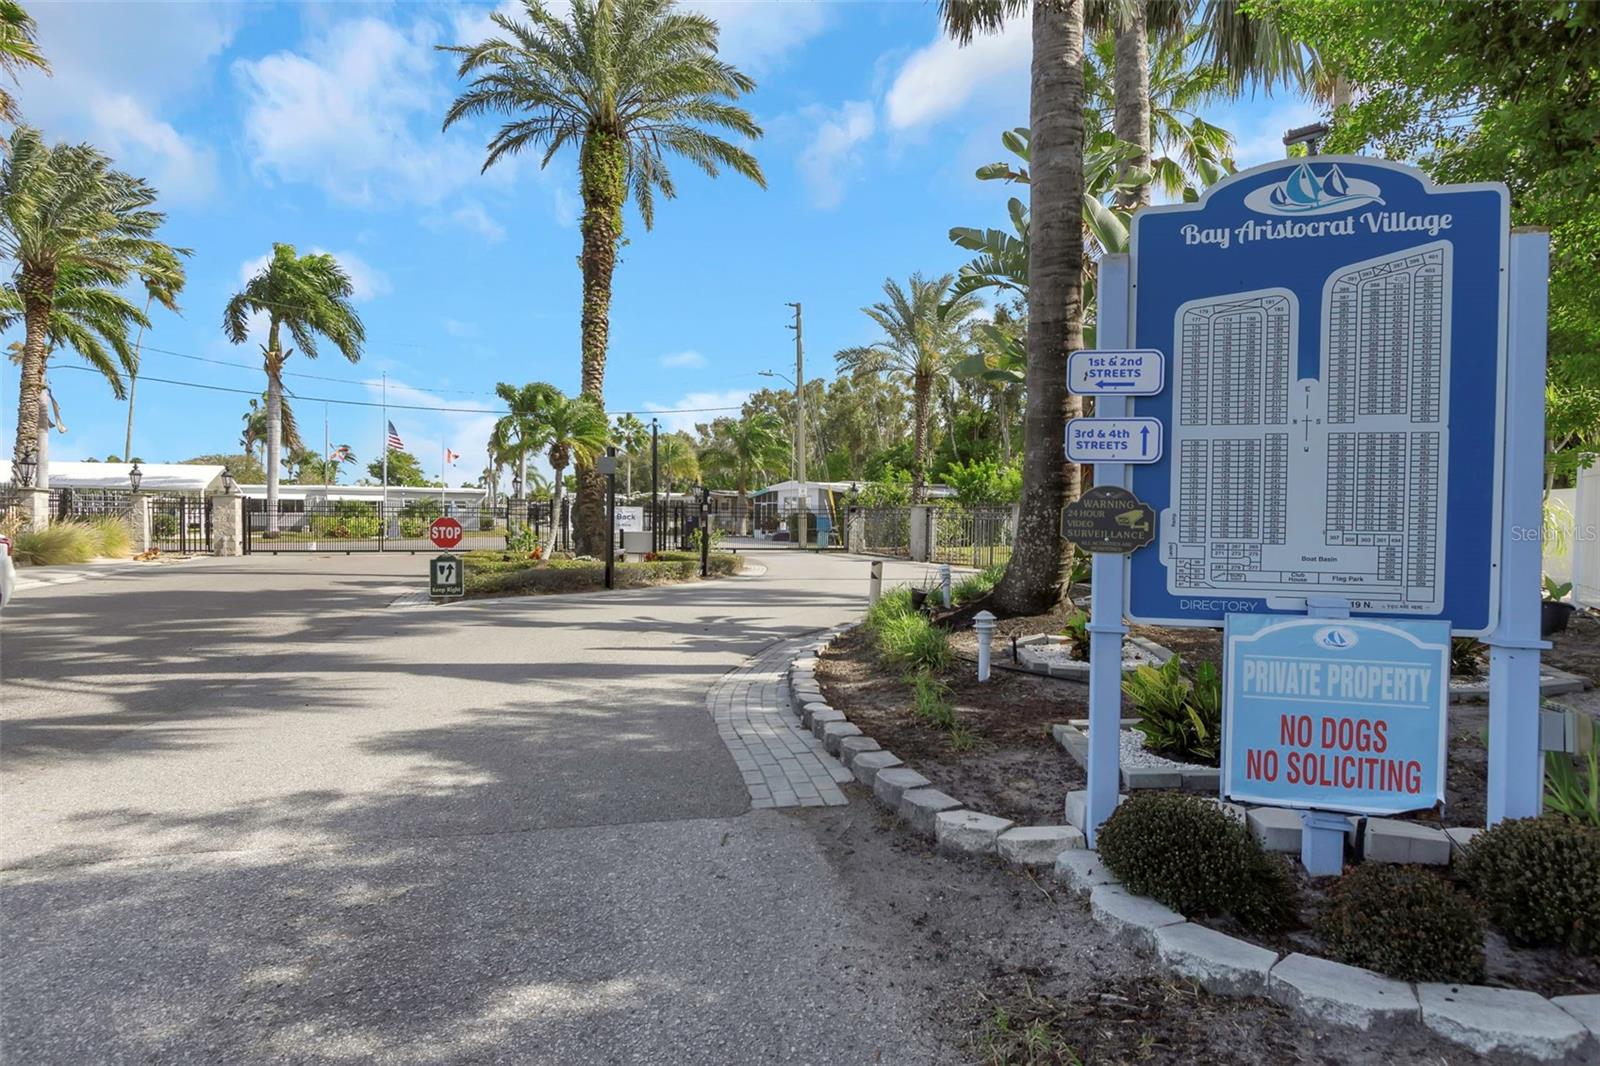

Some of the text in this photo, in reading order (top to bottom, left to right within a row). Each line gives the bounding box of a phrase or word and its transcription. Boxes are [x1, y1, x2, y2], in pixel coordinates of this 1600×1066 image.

[1180, 211, 1452, 248] Bay Aristocrat Village
[1088, 357, 1143, 366] 1st & 2nd
[1089, 369, 1142, 378] STREETS
[1075, 429, 1130, 438] 3rd & 4th
[1076, 441, 1128, 450] STREETS
[1083, 500, 1135, 509] WARNING
[432, 527, 461, 539] STOP
[1067, 529, 1144, 539] SURVEILLANCE
[1180, 599, 1258, 612] DIRECTORY
[1242, 659, 1432, 702] PRIVATE PROPERTY
[1280, 714, 1388, 753] NO DOGS
[1247, 749, 1421, 794] NO SOLICITING
